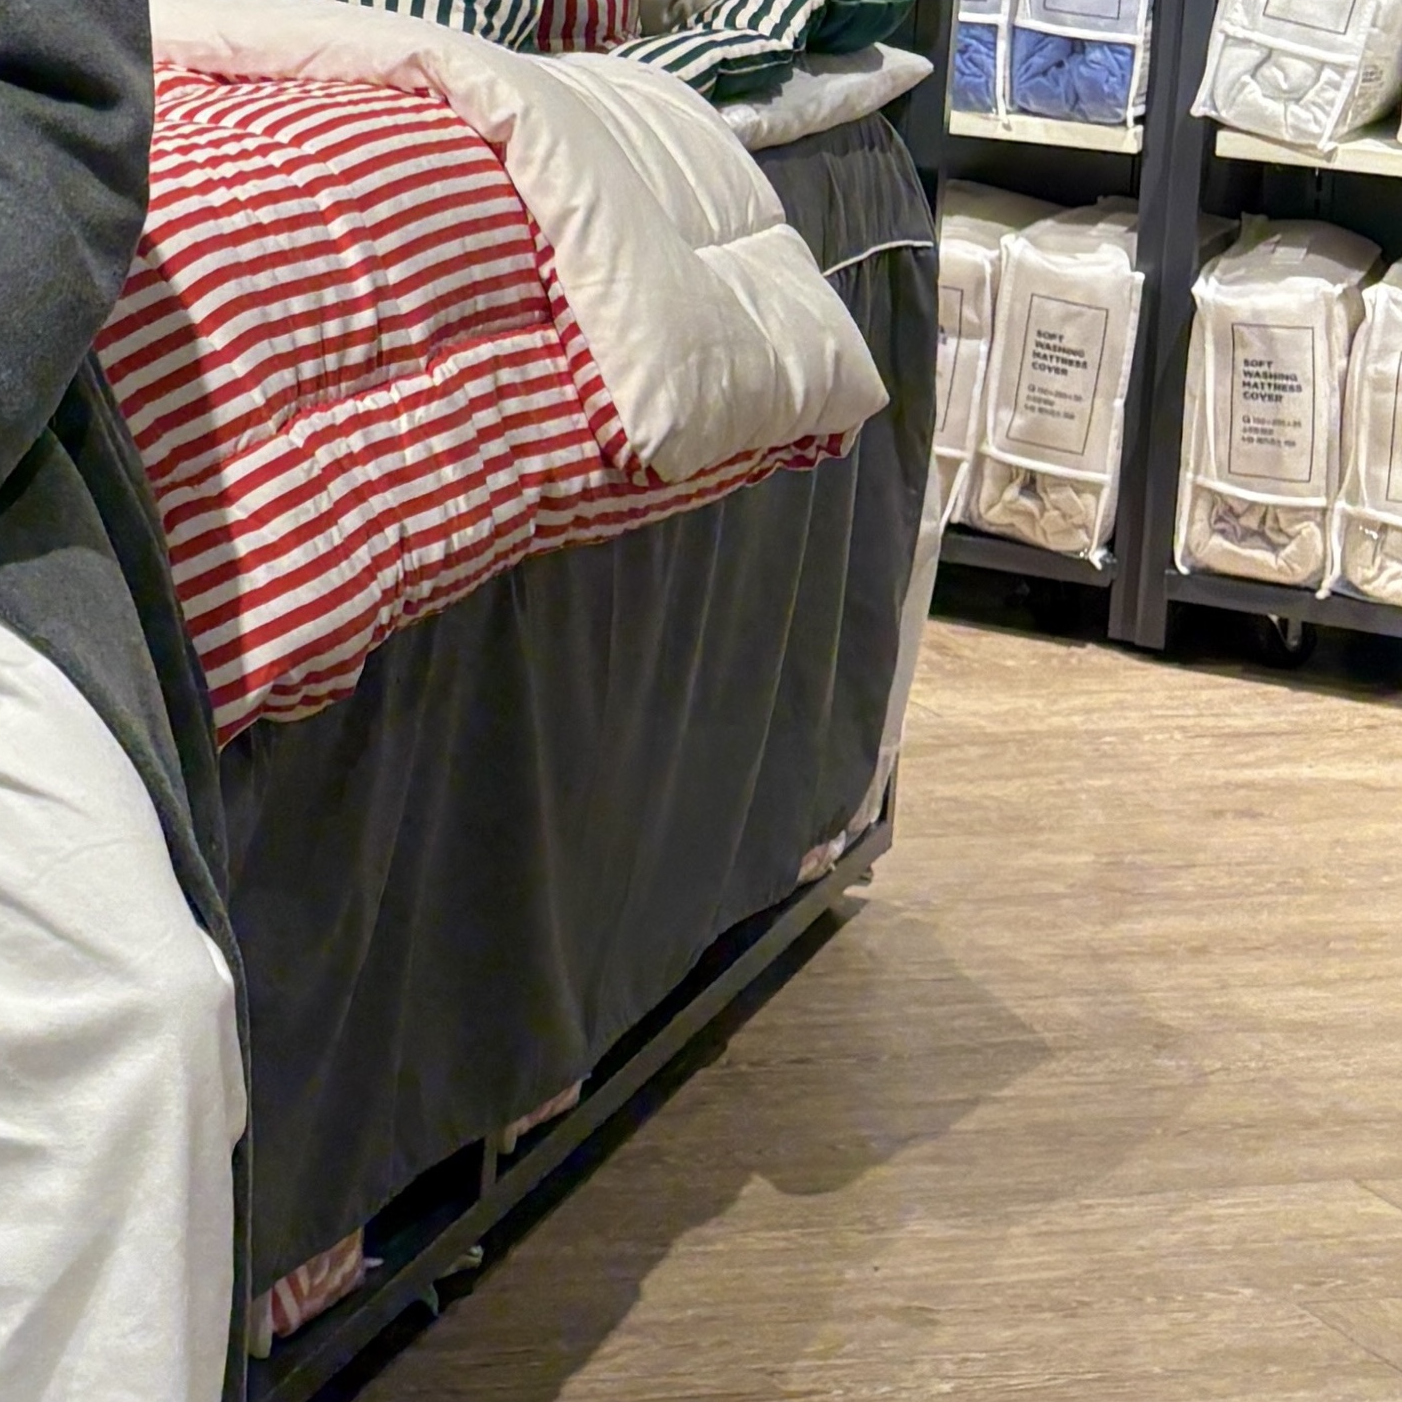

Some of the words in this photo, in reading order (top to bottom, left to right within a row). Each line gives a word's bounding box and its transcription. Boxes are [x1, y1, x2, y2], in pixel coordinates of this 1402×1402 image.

[1036, 329, 1064, 344] SOFT
[1032, 350, 1088, 371] MATTRESS
[1243, 358, 1274, 370] SOFT
[1031, 361, 1069, 377] COVER
[1242, 380, 1303, 394] MATTRESS
[1242, 391, 1284, 404] COVER
